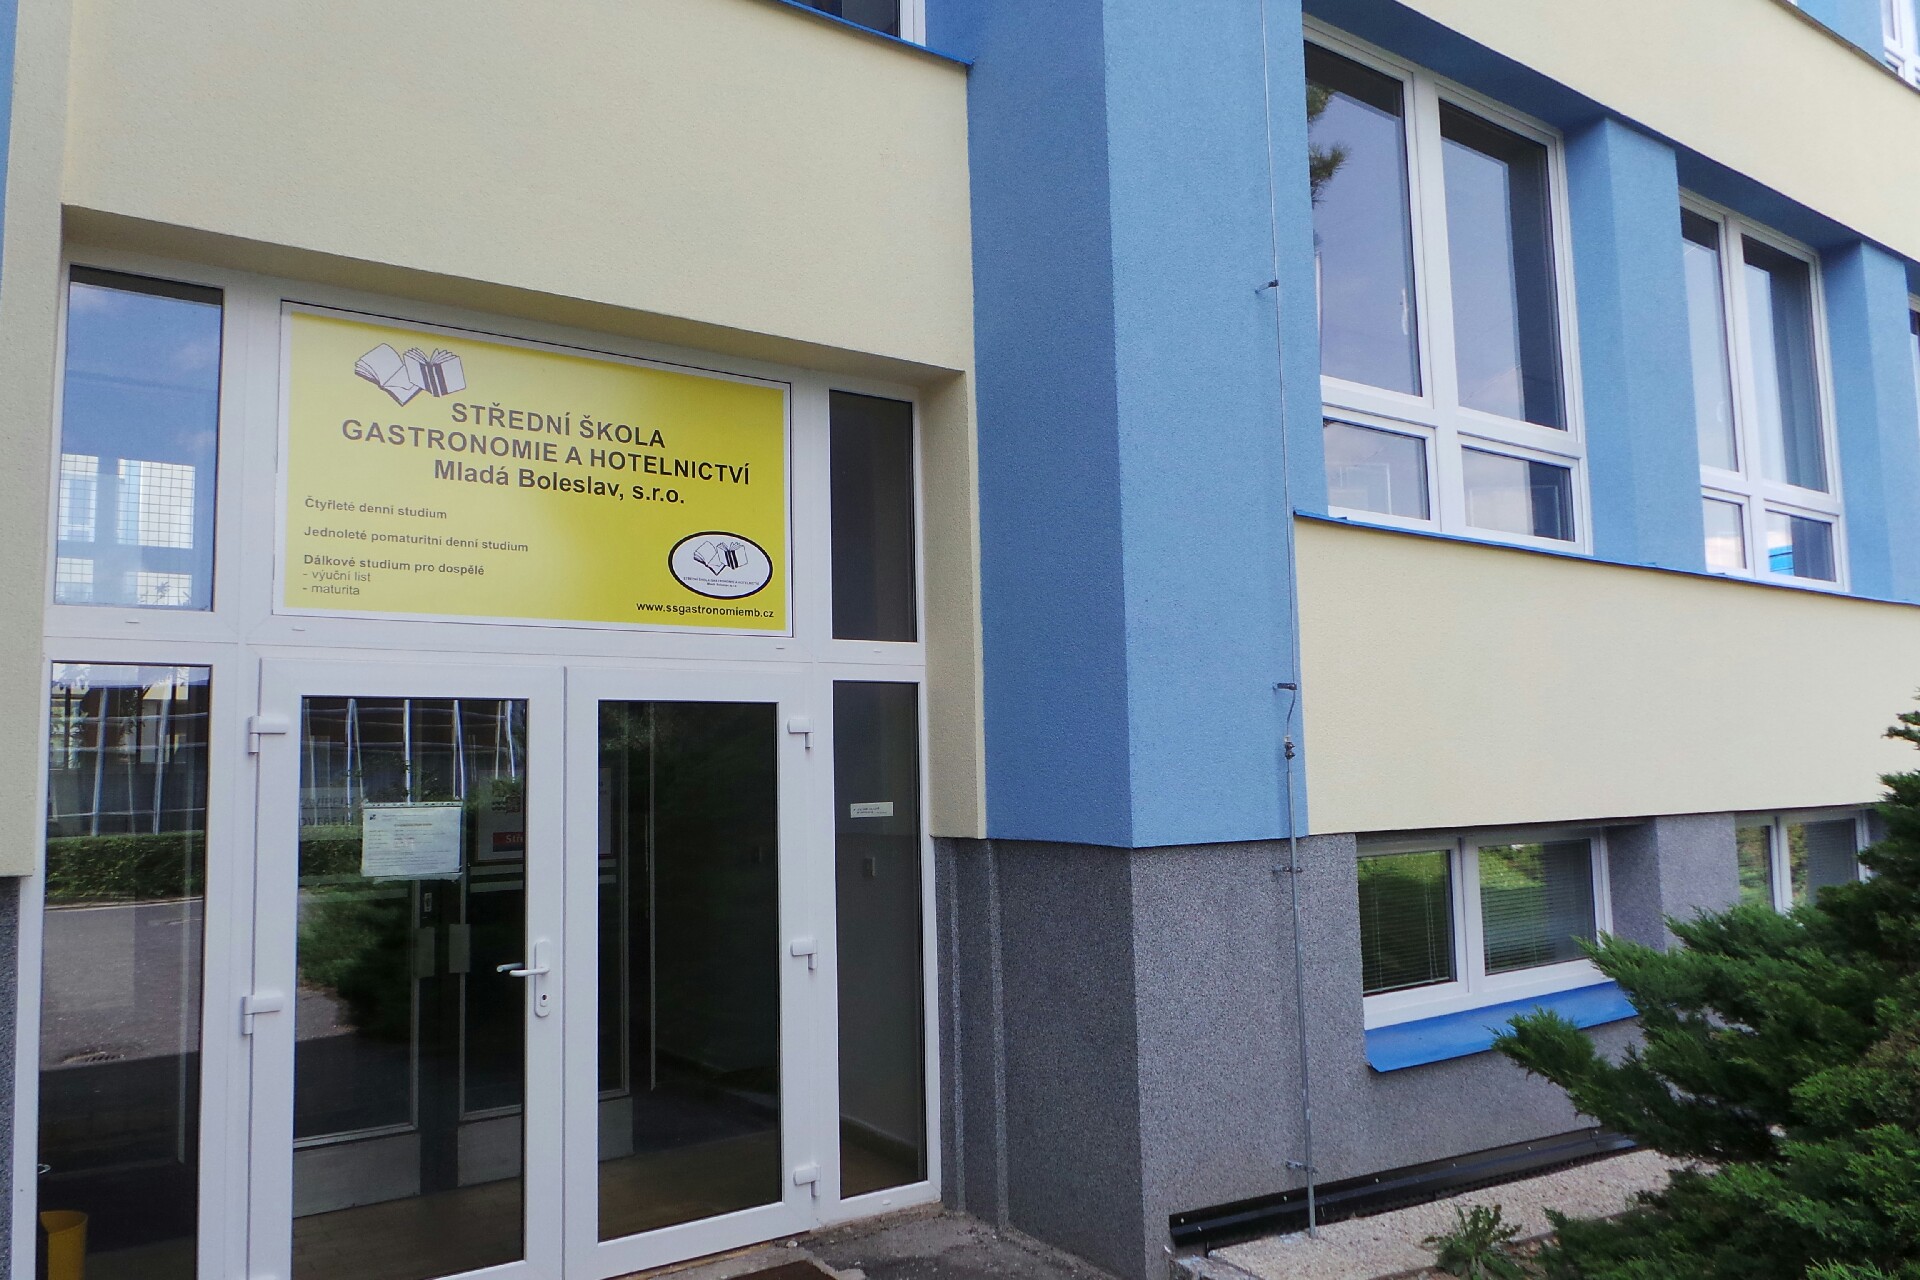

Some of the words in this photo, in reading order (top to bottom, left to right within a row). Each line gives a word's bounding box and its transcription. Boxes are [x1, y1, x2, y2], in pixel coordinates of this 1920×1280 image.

[451, 401, 570, 436] STŘEDNÍ
[579, 414, 665, 449] ŠKOLA
[342, 419, 558, 463] GASTRONOMIE
[564, 446, 583, 466] A
[590, 448, 750, 485] HOTELNICTVÍ
[434, 459, 509, 486] Mladá
[519, 468, 624, 501] Boleslav,
[632, 484, 685, 504] s.r.o.
[304, 495, 355, 511] Čtyřleté
[397, 506, 447, 519] studium
[304, 526, 367, 540] Jednoleté
[371, 531, 442, 546] pomaturitní
[445, 536, 478, 548] denní
[481, 540, 528, 552] studium
[304, 554, 356, 567] Dálkové
[359, 558, 410, 571] studium
[414, 563, 435, 573] pro
[438, 563, 485, 576] dospělé
[312, 569, 351, 581] výuční
[354, 571, 371, 582] list
[311, 584, 360, 595] maturita
[636, 602, 774, 618] www.ssgastronomiemb.cz
